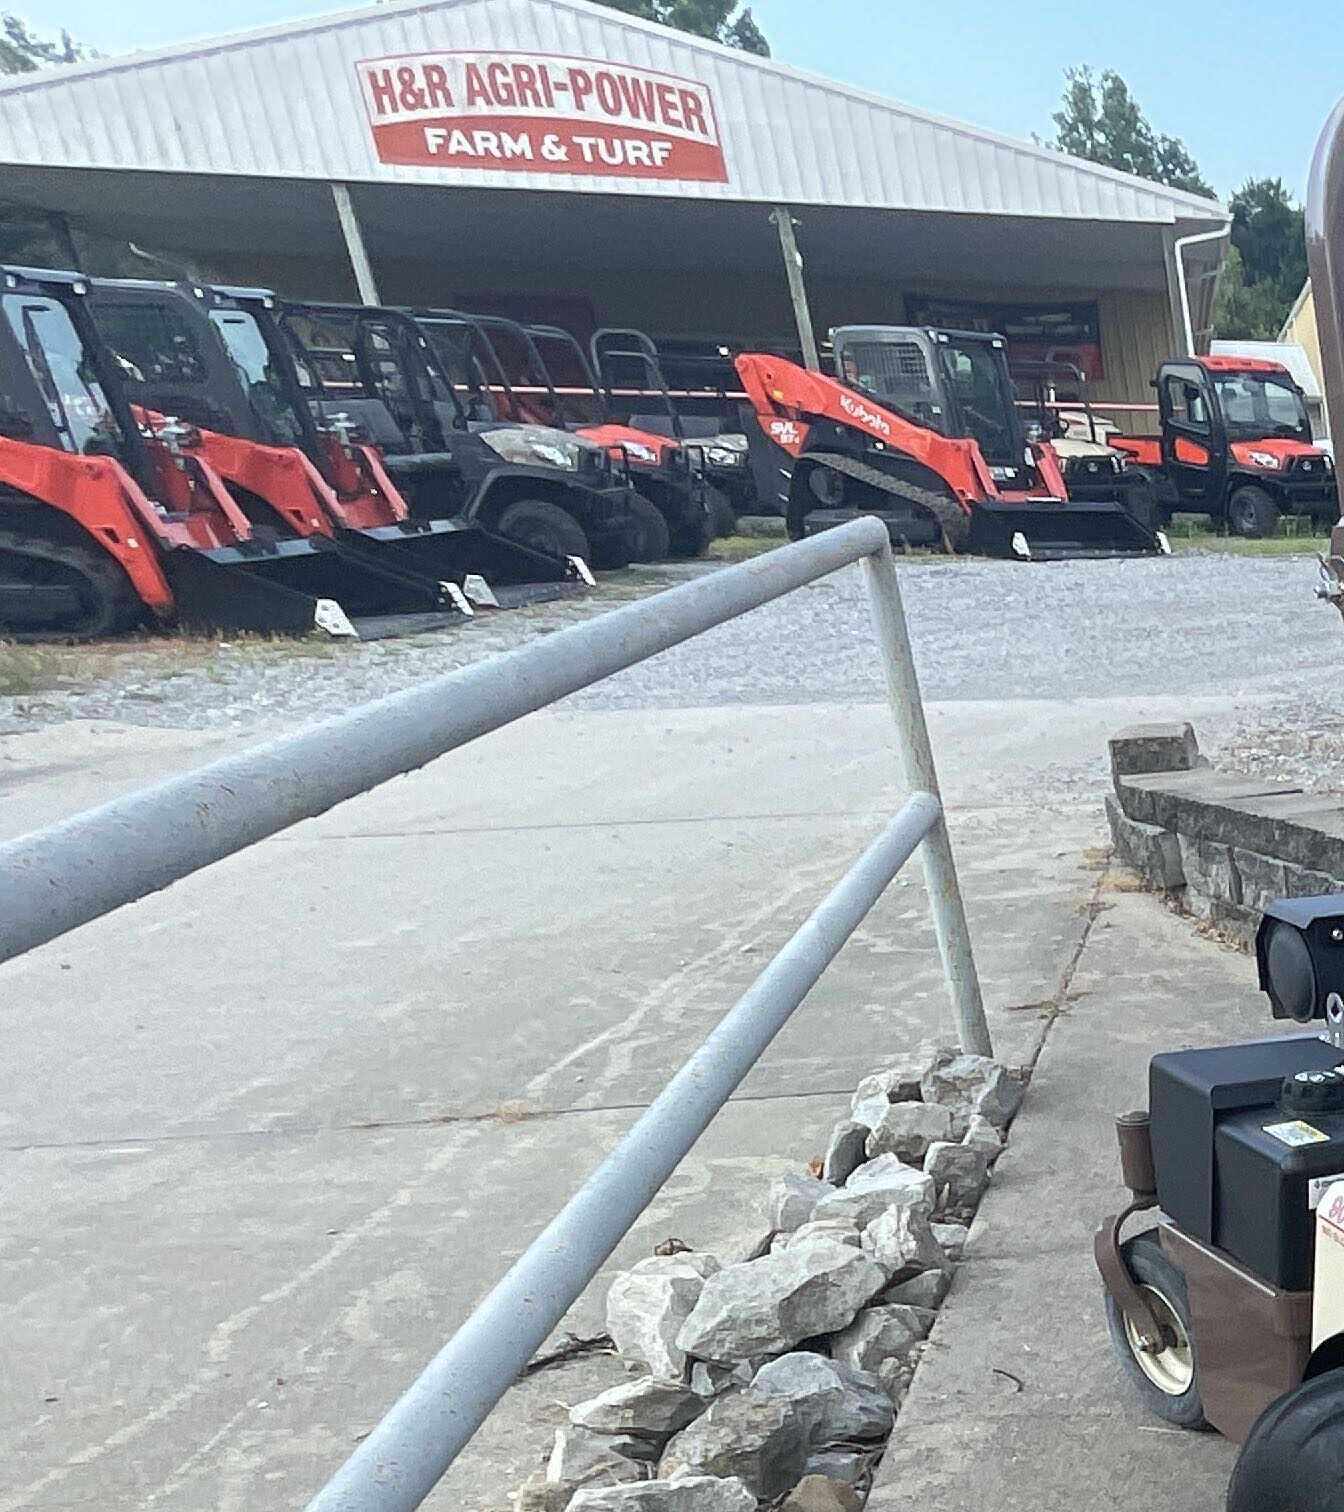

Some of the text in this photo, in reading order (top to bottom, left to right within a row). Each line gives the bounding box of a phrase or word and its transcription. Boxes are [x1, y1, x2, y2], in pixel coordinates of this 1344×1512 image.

[368, 63, 710, 136] H&R AGRI-POWER
[424, 128, 673, 168] FARM & TURF
[840, 394, 891, 436] Kubota
